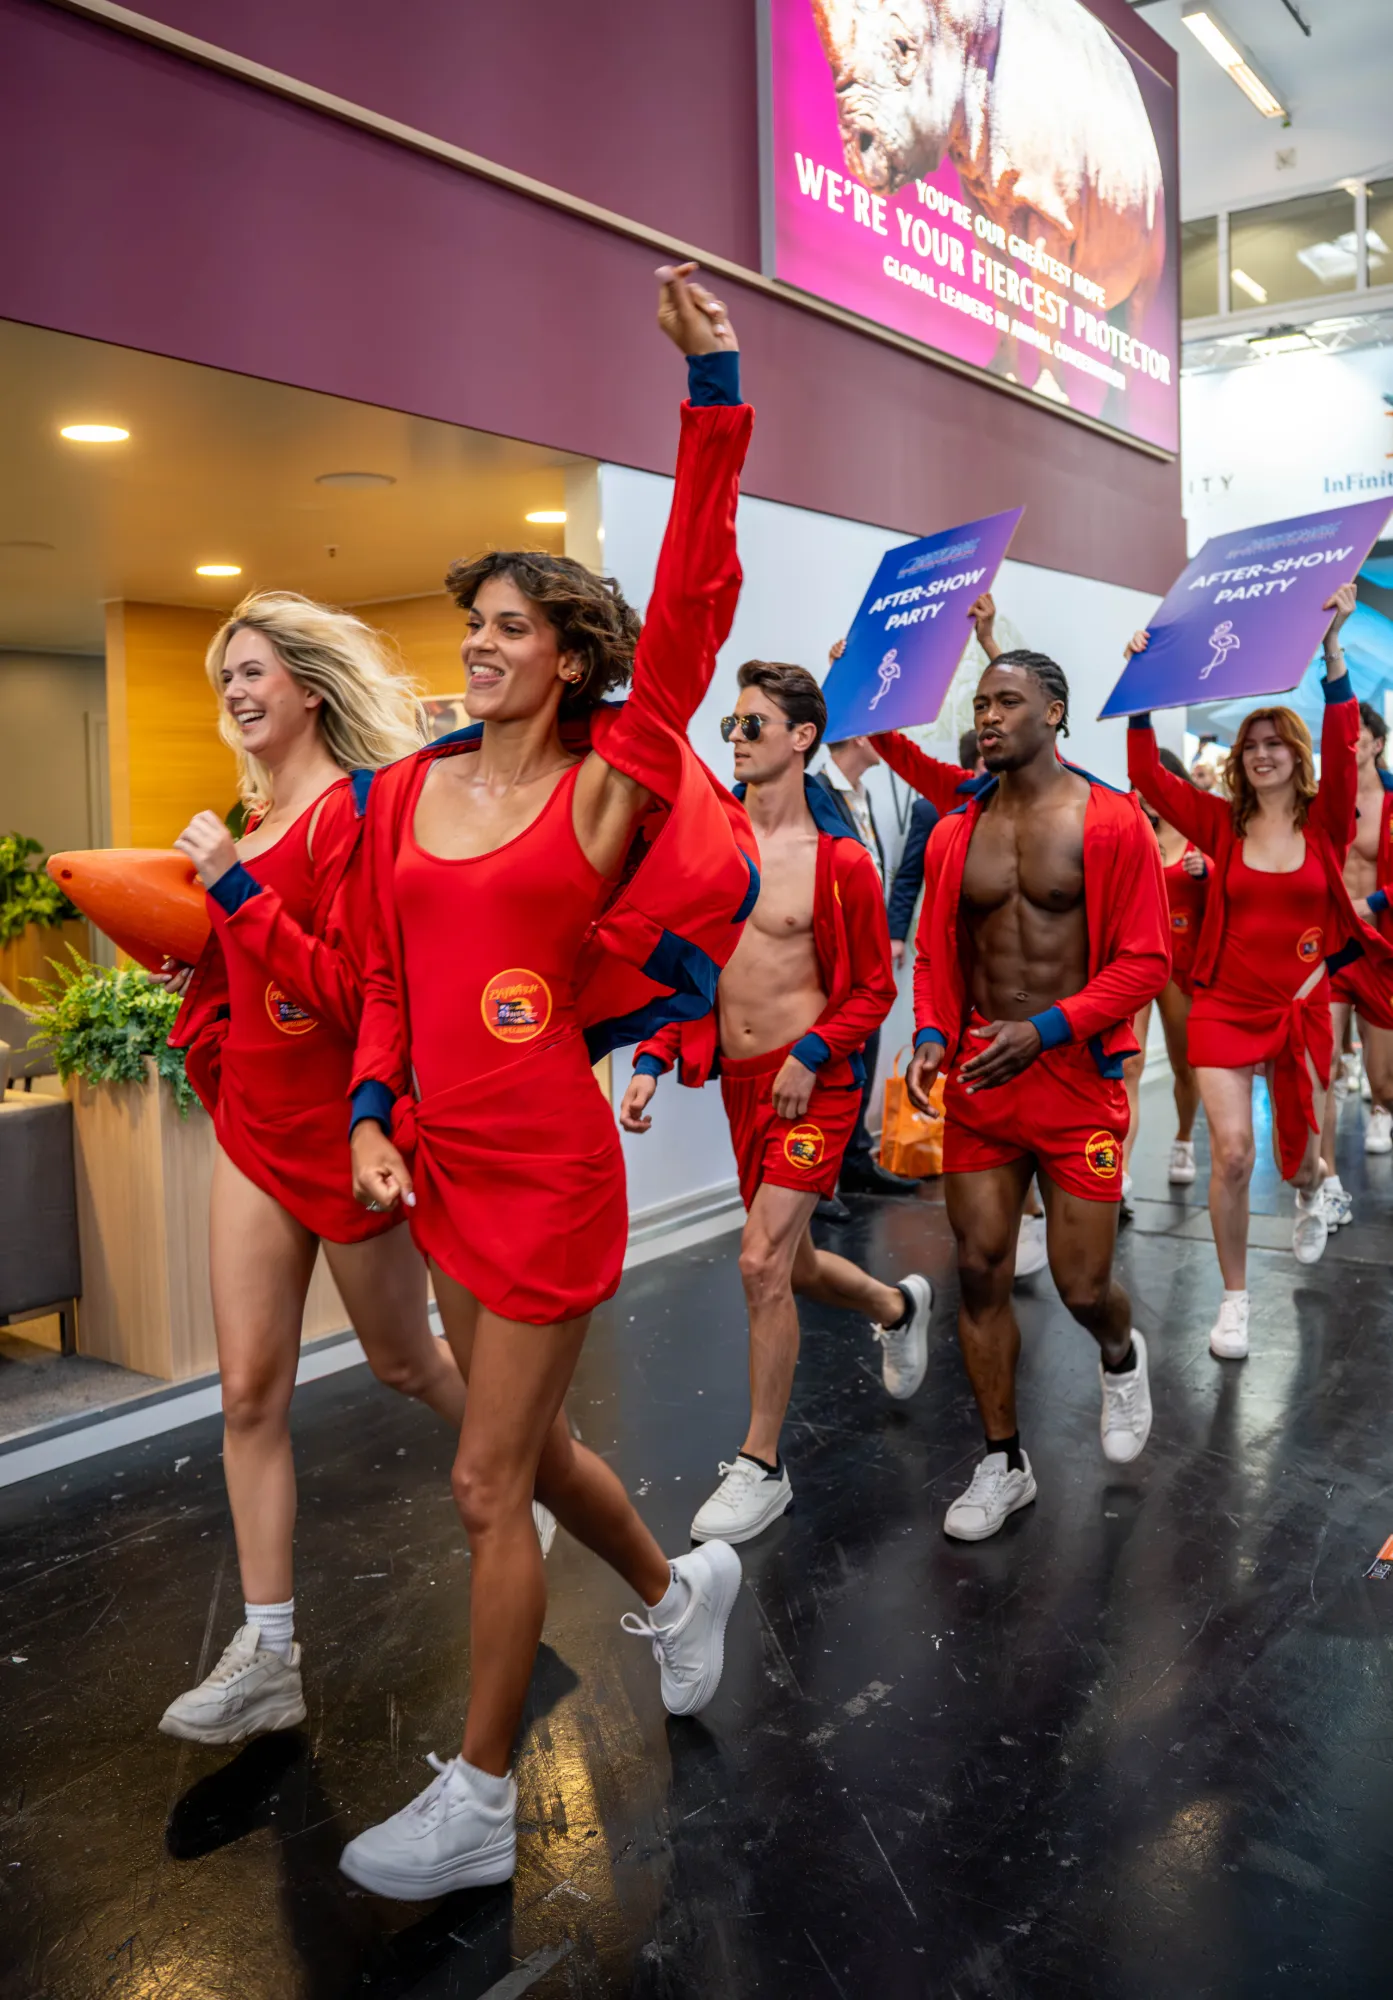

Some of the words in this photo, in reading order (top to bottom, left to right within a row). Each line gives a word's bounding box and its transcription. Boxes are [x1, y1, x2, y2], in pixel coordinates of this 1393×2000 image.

[915, 178, 973, 231] YOU'RE
[974, 214, 1006, 250] OUR
[1008, 234, 1073, 288] GREATEST
[794, 151, 888, 236] WE'RE
[895, 207, 966, 276] YOUR
[970, 248, 1070, 330] FIERCEST
[1072, 305, 1171, 386] PROTECTOR
[882, 255, 938, 298] GLOBAL
[939, 282, 994, 326] LEADERS
[994, 310, 1010, 333] IN
[868, 567, 987, 615] AFTER-SHOW
[1187, 545, 1355, 591] AFTER-SHOW
[1213, 576, 1298, 605] PARTY
[884, 601, 946, 632] PARTY
